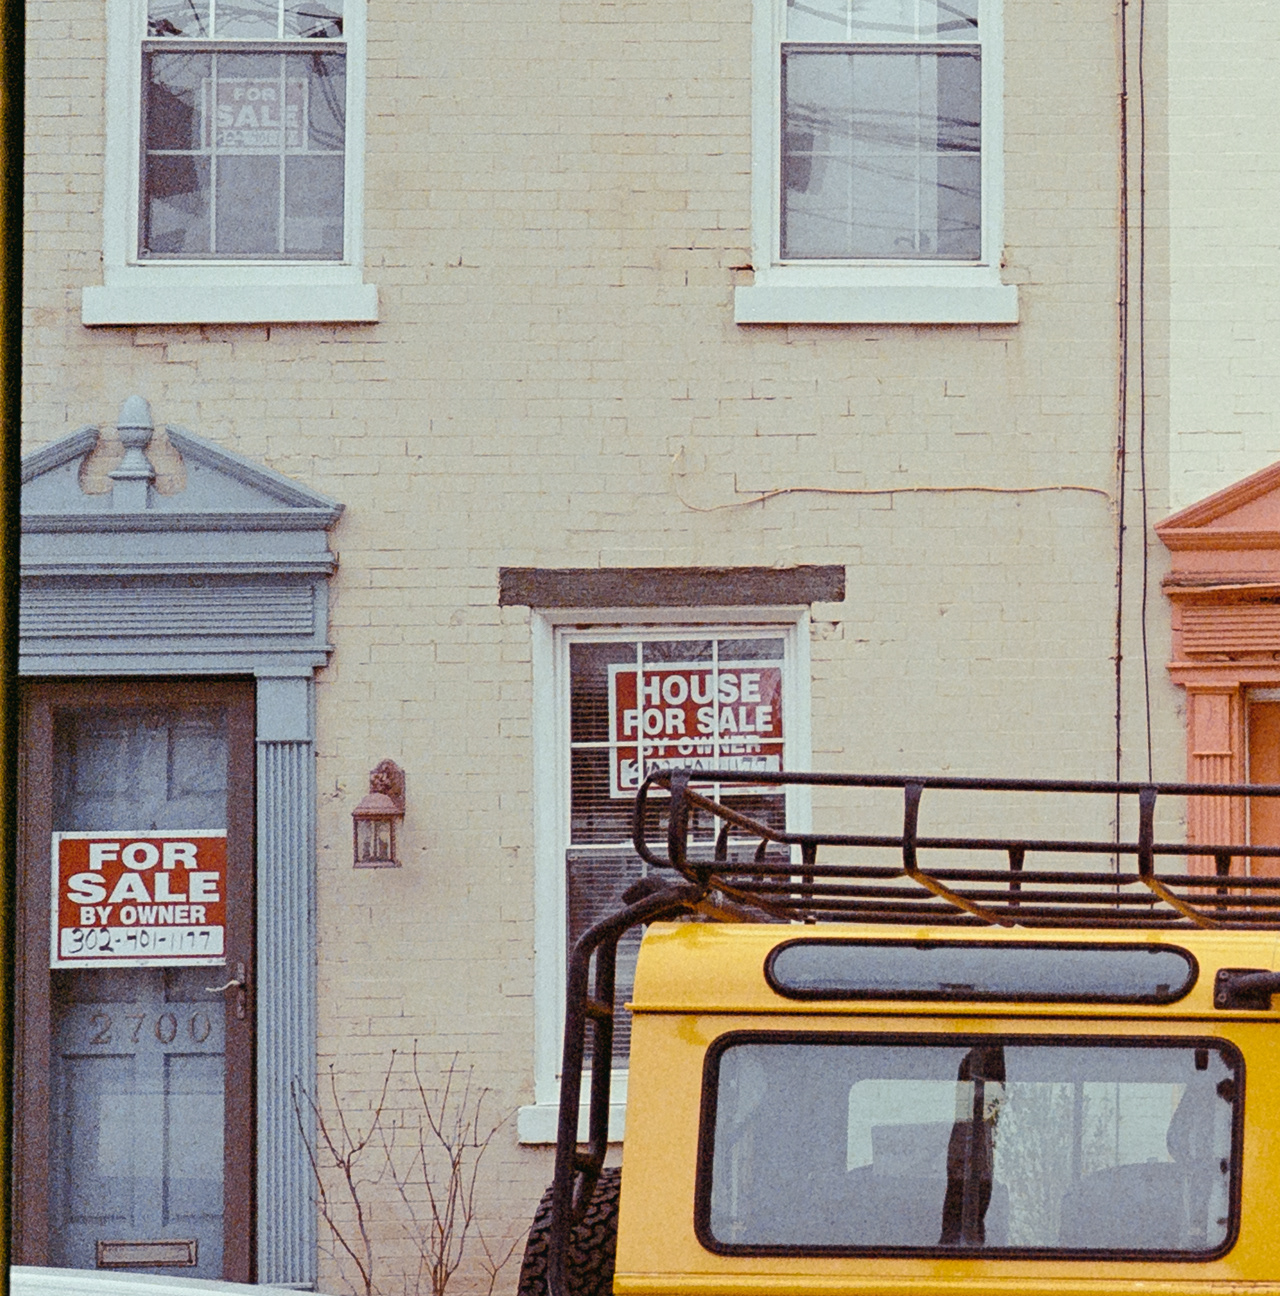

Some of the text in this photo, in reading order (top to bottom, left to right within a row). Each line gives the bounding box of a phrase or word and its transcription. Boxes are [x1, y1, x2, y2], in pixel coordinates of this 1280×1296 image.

[232, 87, 276, 102] FOR
[216, 104, 299, 127] SALE
[639, 673, 761, 706] HOUSE
[623, 705, 773, 736] FOR SALE
[88, 841, 198, 871] FOR
[66, 871, 220, 904] SALE
[80, 905, 206, 925] BY OWNER
[89, 1012, 211, 1045] 2700
